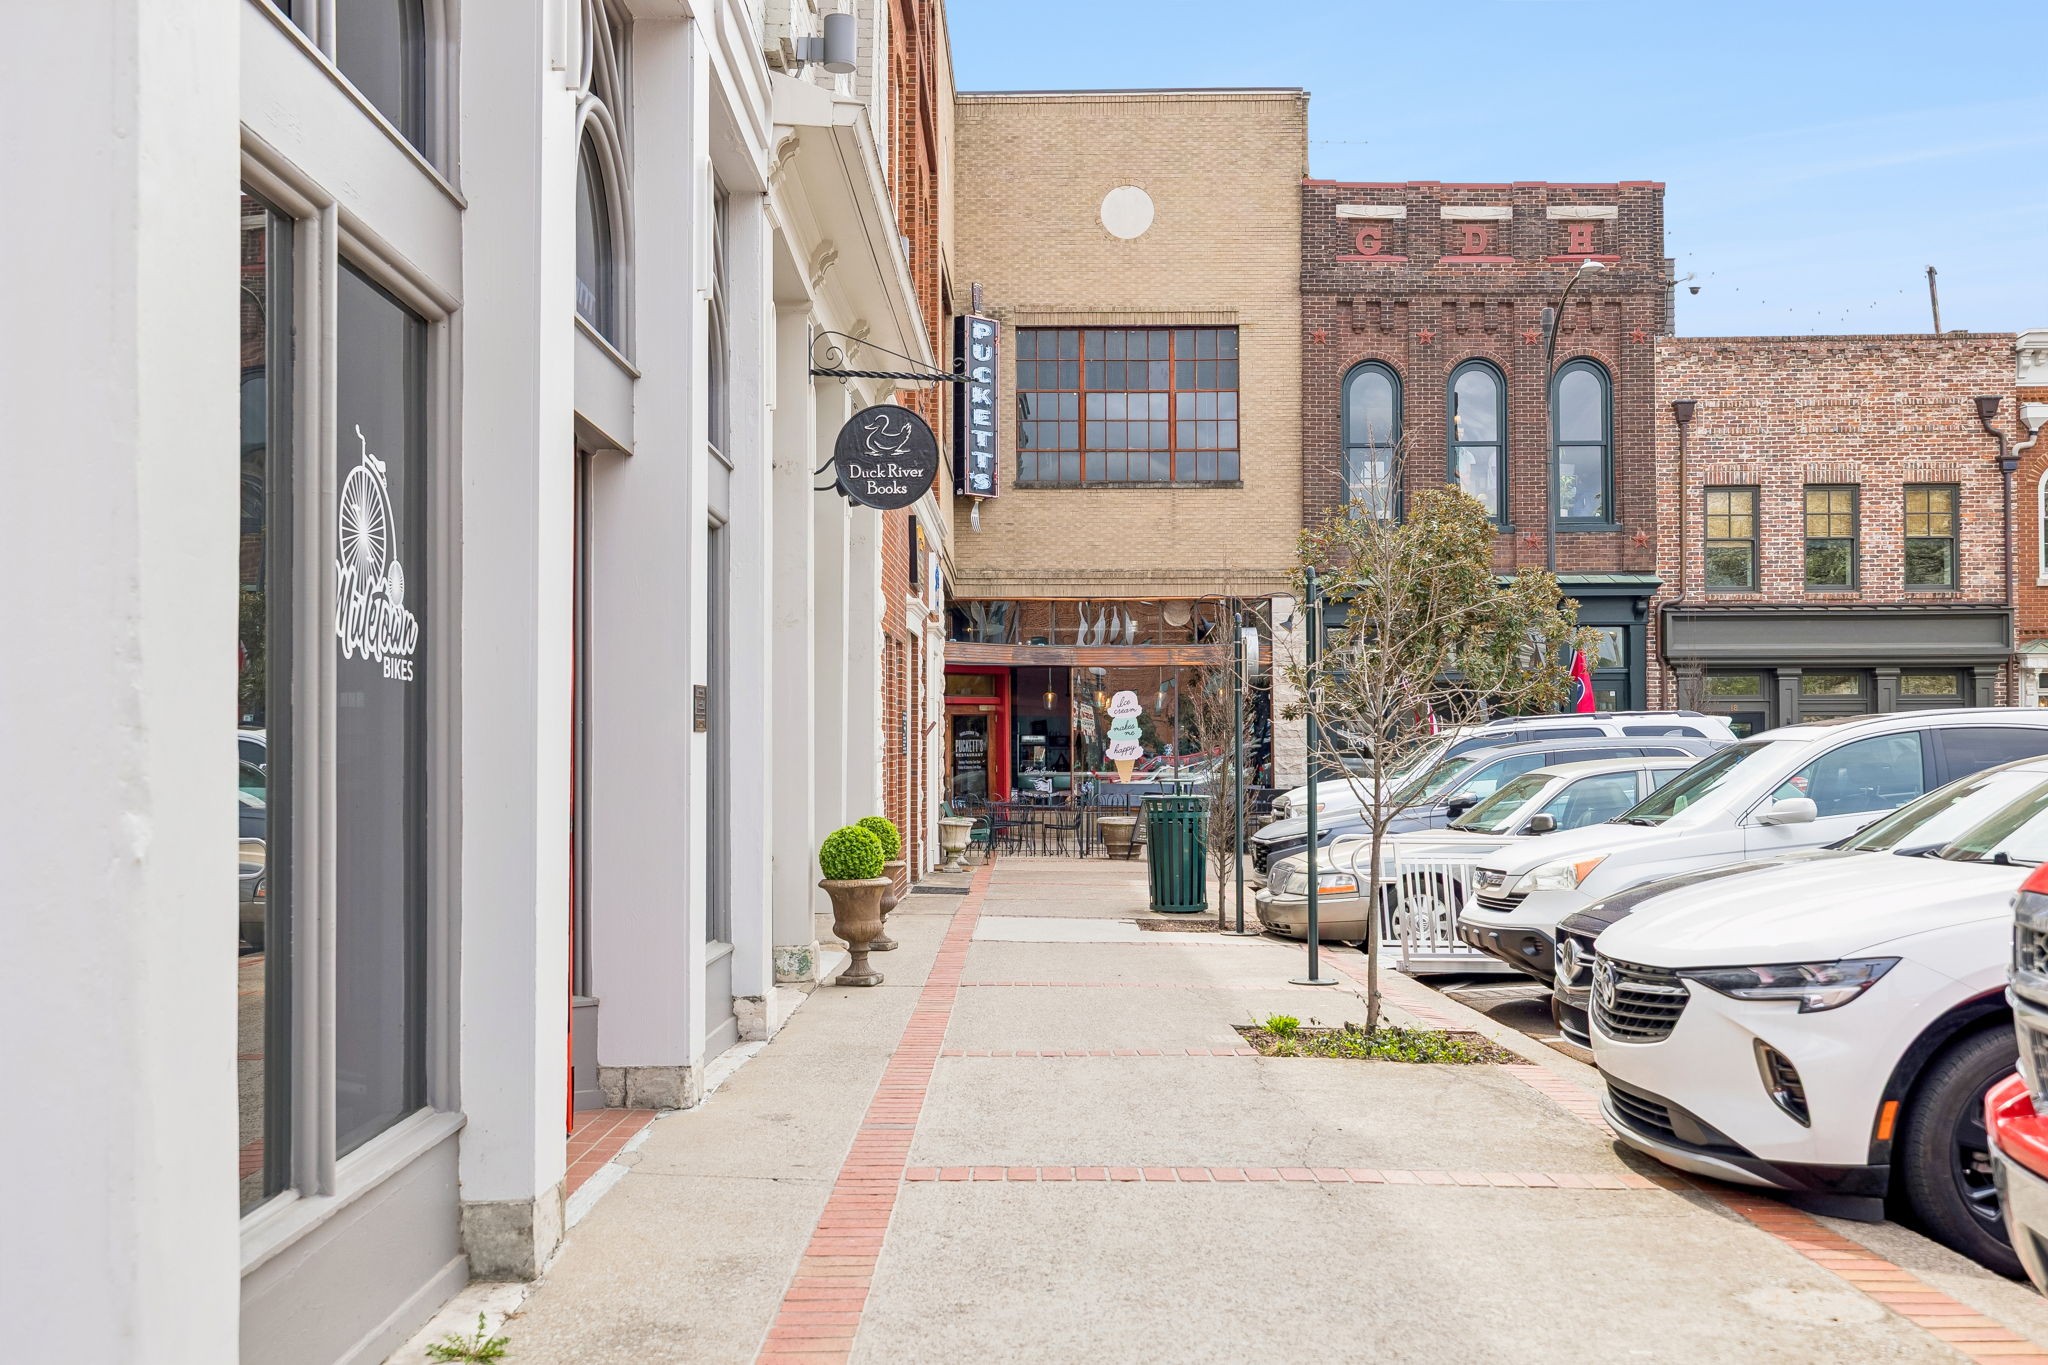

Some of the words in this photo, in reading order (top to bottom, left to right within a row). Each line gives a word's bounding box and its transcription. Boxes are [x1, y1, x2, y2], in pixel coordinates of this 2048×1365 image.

[1355, 226, 1382, 255] G
[1461, 225, 1488, 254] D
[1568, 223, 1595, 254] H
[969, 320, 993, 490] PUCKETT'S
[849, 464, 885, 478] Duck
[887, 463, 924, 478] River
[867, 480, 907, 495] Books
[383, 656, 414, 682] BIKES
[1117, 696, 1131, 708] Ice
[1113, 707, 1137, 715] cream
[1113, 719, 1135, 732] makes
[1113, 743, 1137, 756] happy
